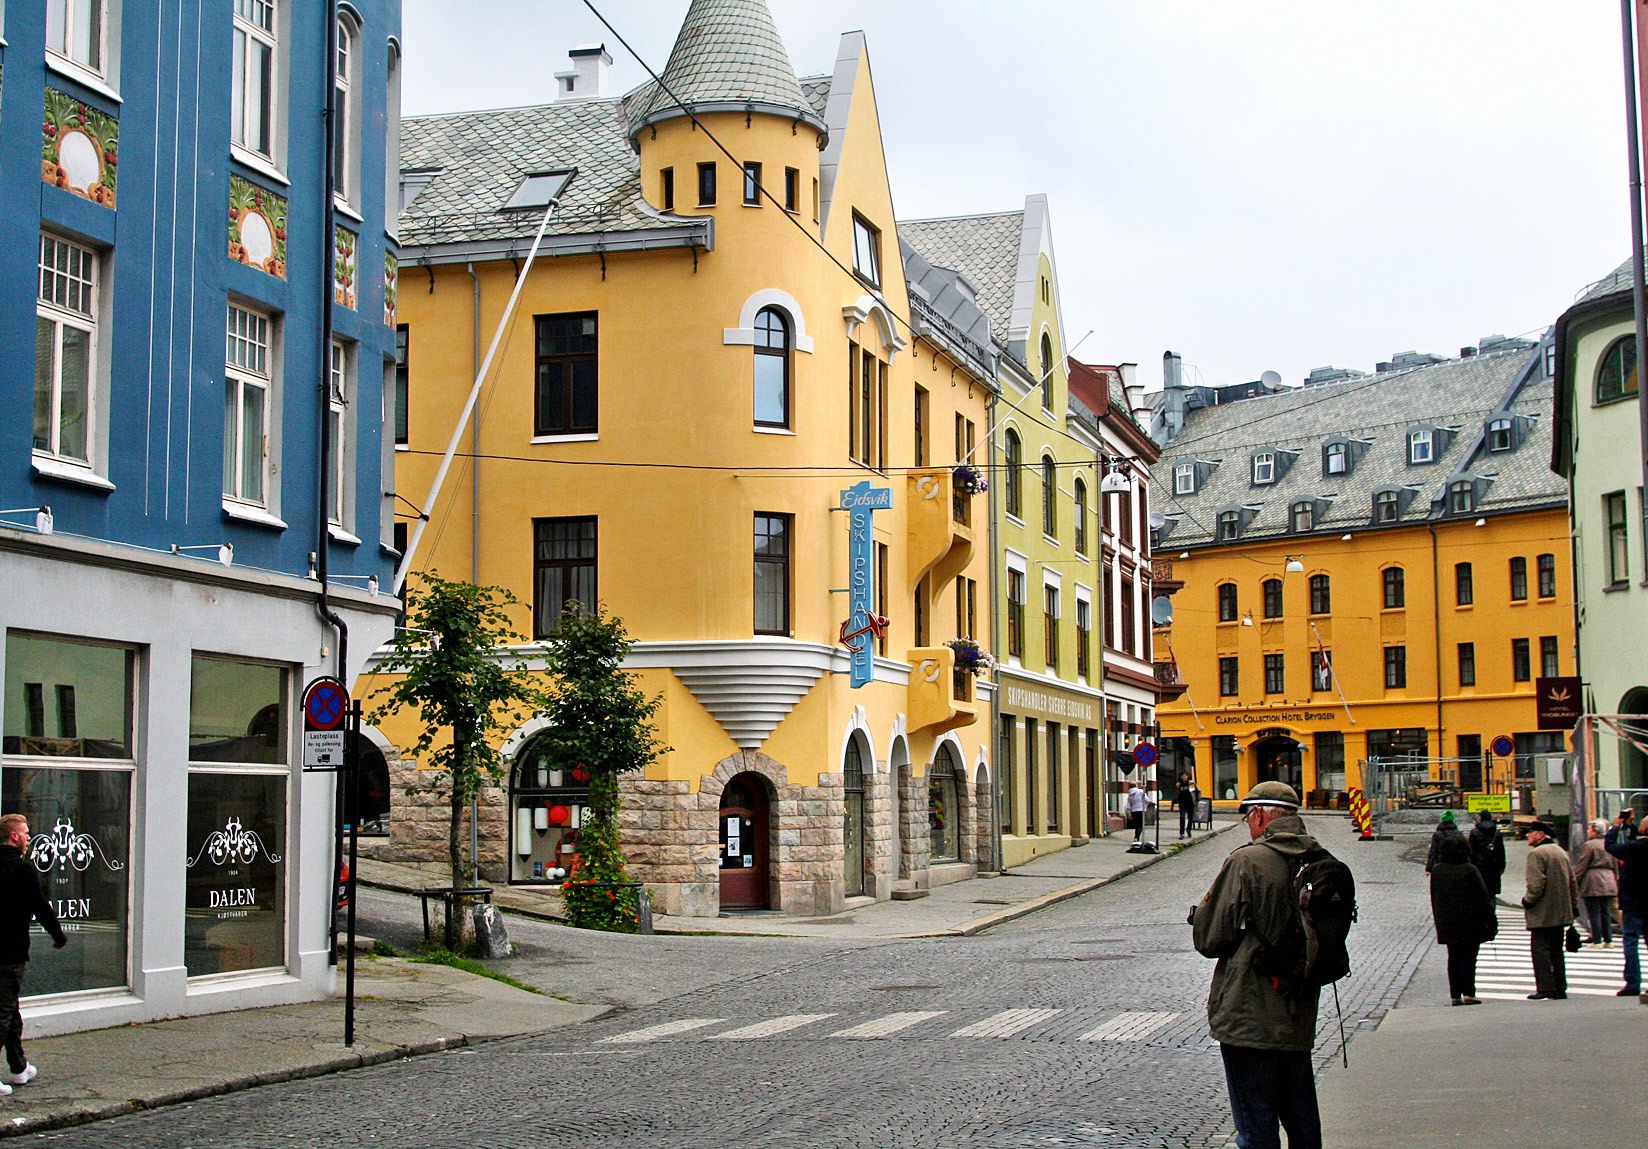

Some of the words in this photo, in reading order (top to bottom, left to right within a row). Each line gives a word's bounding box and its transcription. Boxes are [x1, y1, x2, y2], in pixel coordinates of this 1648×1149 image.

[841, 489, 890, 509] Eidsvik
[853, 513, 867, 681] SKIPSHANDEL
[1008, 686, 1047, 712] SKIPSHANDLER
[1048, 696, 1066, 716] SVERRE
[210, 888, 255, 908] DALEN
